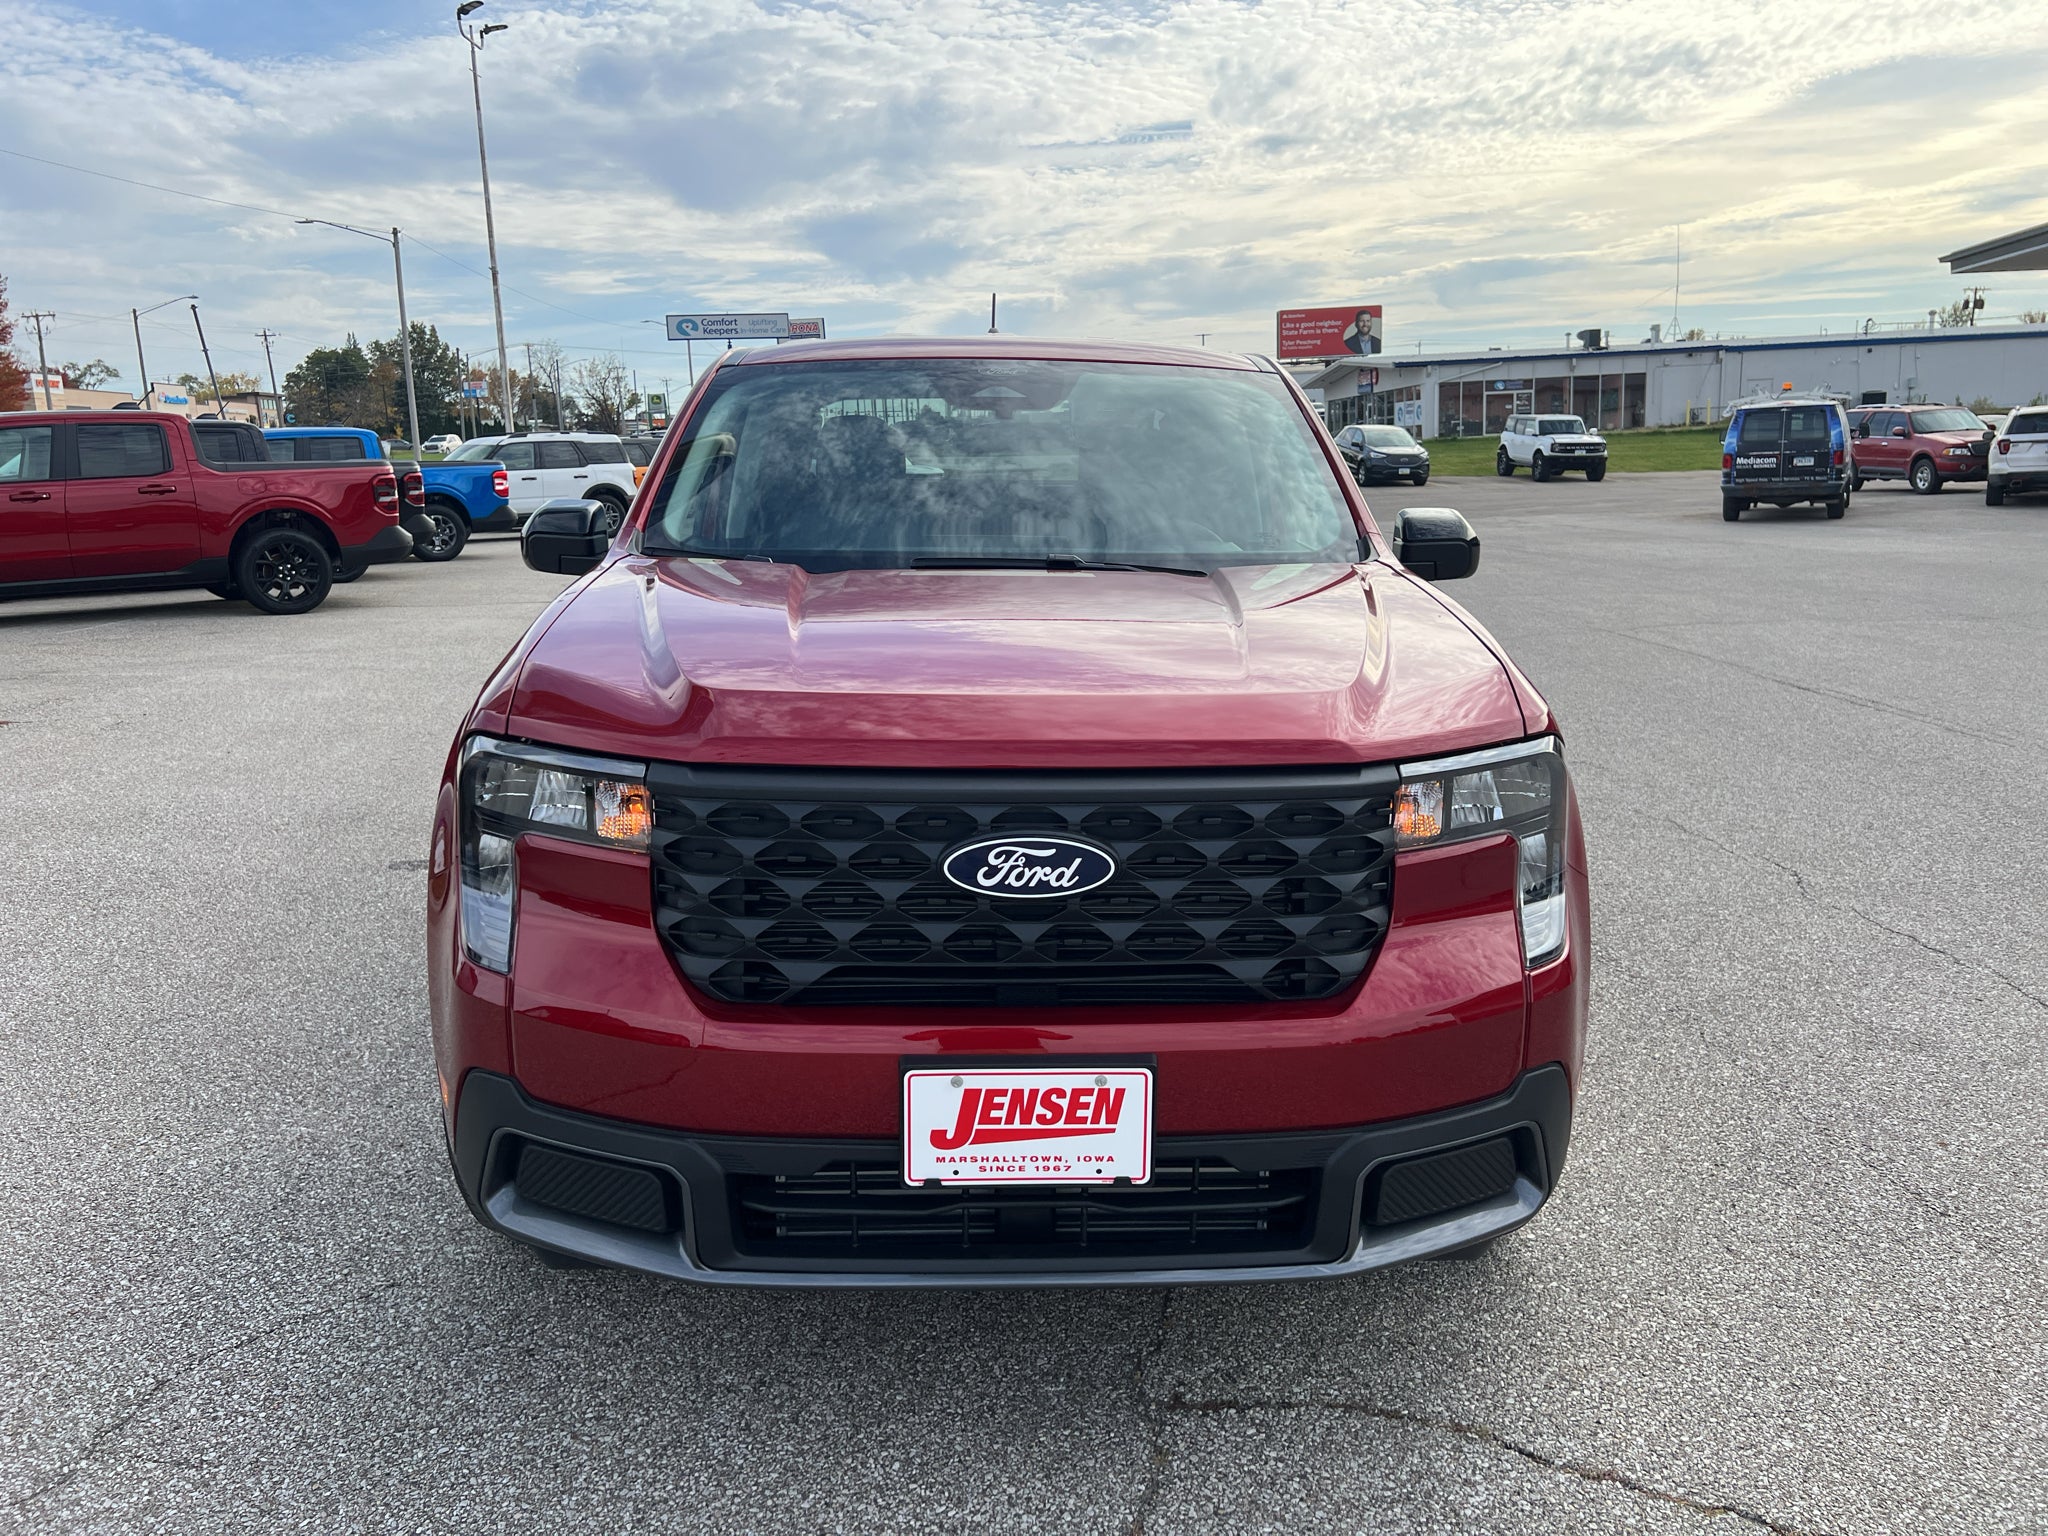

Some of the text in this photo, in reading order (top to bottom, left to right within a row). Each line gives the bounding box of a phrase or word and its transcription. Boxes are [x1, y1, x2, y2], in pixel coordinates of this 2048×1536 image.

[701, 317, 738, 327] Comfort
[748, 319, 778, 328] Uplifting
[703, 327, 739, 336] Keepers
[1736, 456, 1777, 465] Mediacom
[976, 845, 1083, 888] Ford
[929, 1087, 1126, 1150] JENSEN
[935, 1155, 1115, 1164] MARSHALLTOWN, IOWA
[978, 1164, 1073, 1173] SINCE 1967
